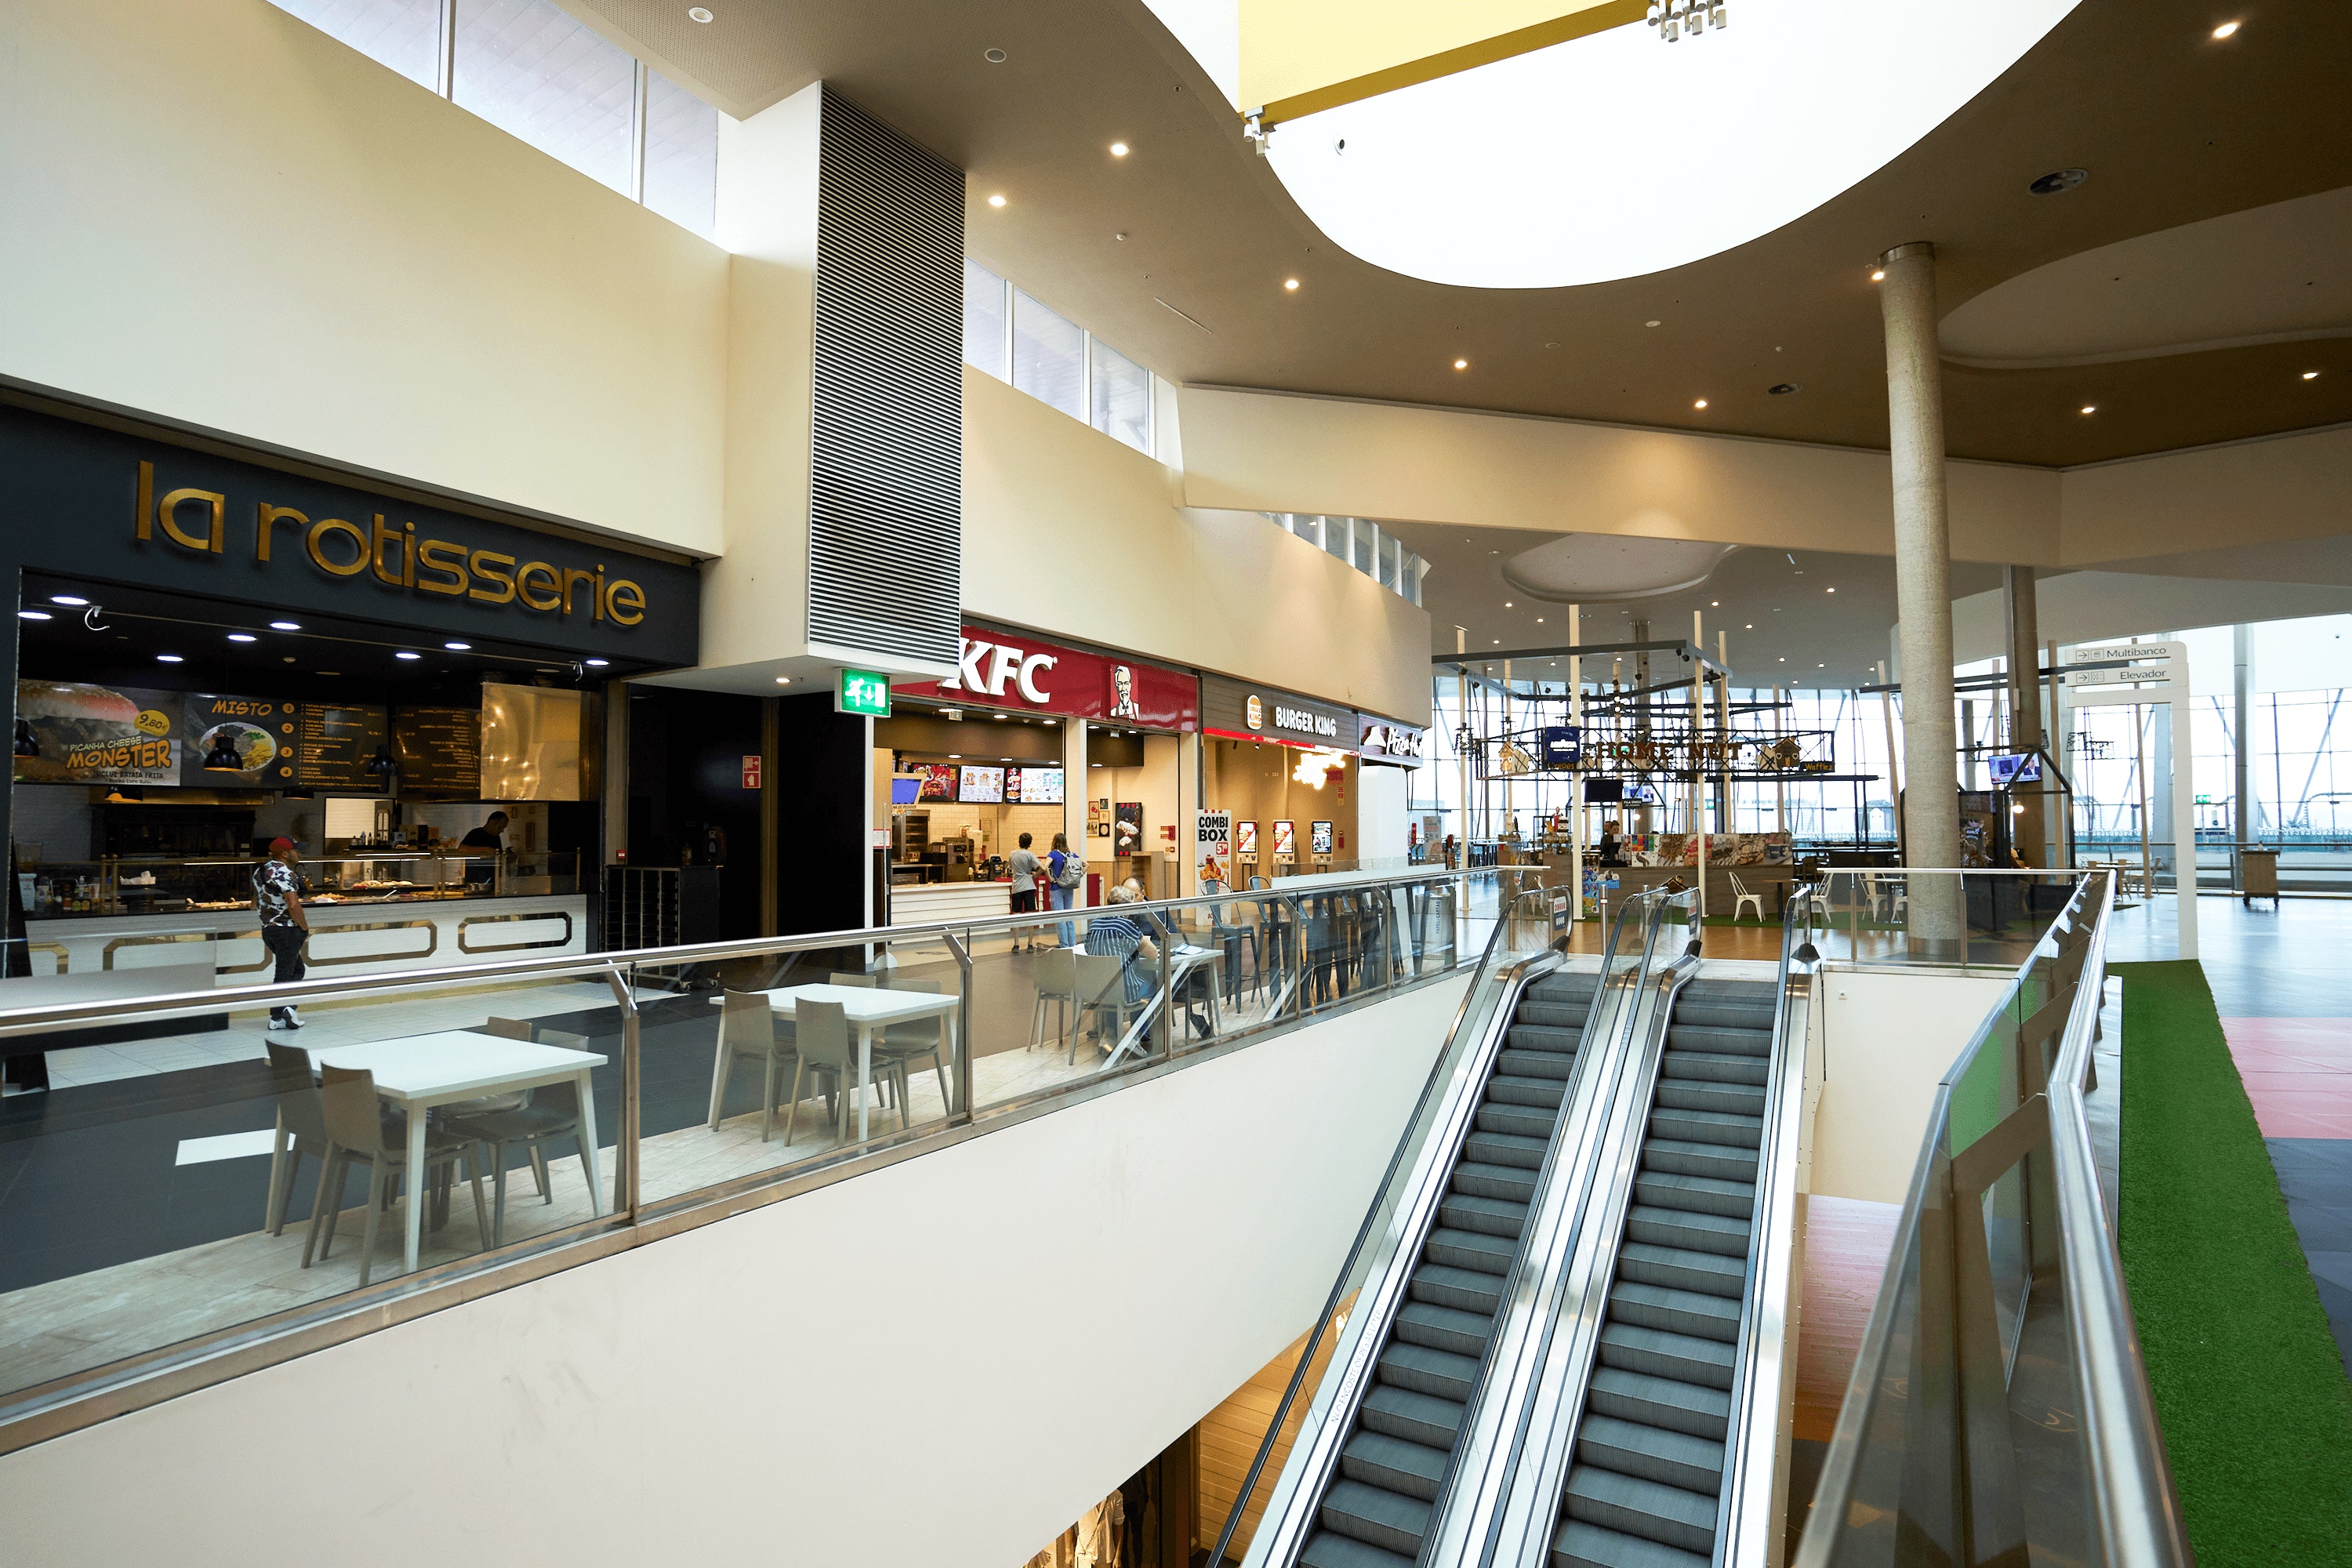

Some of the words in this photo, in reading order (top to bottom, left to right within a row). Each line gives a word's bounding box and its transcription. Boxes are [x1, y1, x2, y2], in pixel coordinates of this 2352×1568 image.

[136, 460, 226, 554] la
[257, 502, 648, 626] rotisserie
[2107, 648, 2166, 658] Multibanco
[937, 637, 1054, 703] KFC
[2120, 670, 2166, 680] Elevador
[212, 700, 273, 717] MISTO
[1275, 706, 1315, 733] BURGER
[1314, 714, 1337, 737] KING
[70, 742, 105, 753] PICANHA
[107, 736, 142, 749] CHEESE
[1386, 726, 1410, 756] Pizza
[67, 739, 172, 769] MONSTER
[1597, 742, 1675, 760] HOME
[1686, 742, 1743, 760] NUT
[1199, 816, 1229, 828] COMBI
[1198, 829, 1228, 842] BOX
